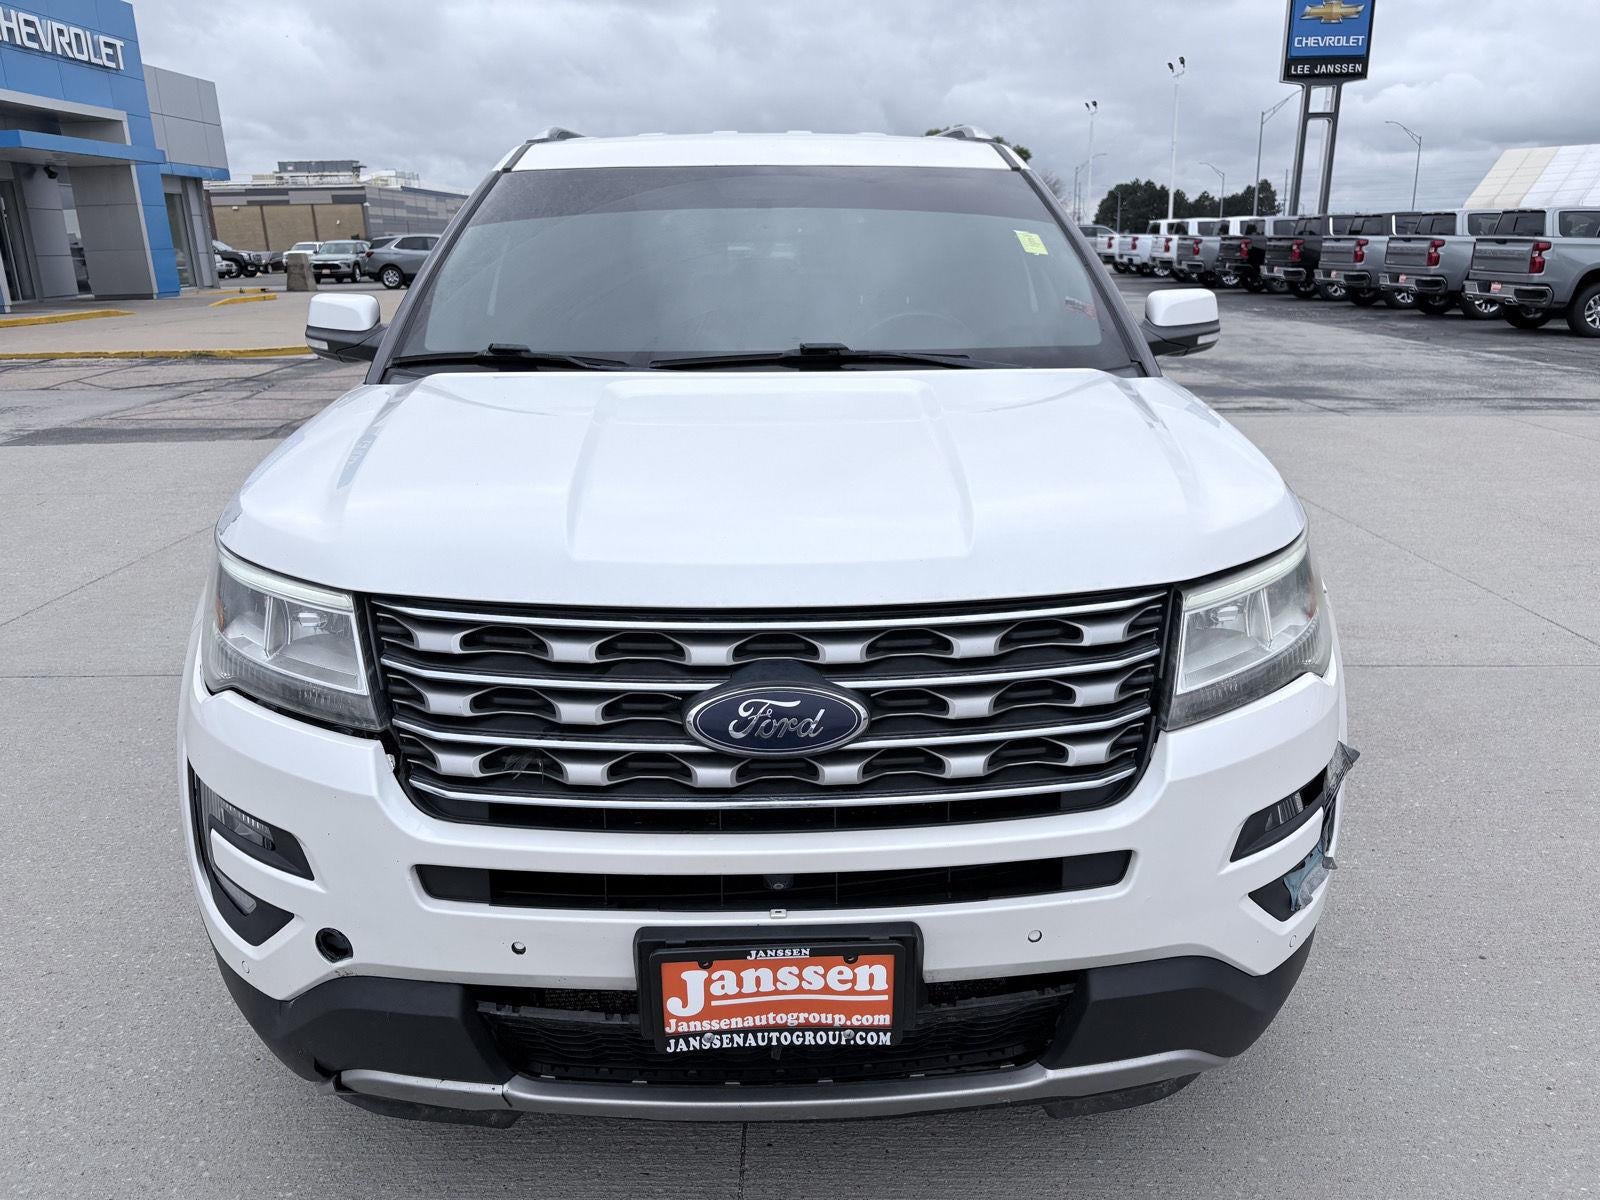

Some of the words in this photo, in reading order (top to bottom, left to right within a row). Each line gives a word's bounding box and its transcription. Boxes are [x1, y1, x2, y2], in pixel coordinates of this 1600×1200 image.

[0, 6, 124, 70] HEVROLET
[1294, 35, 1365, 47] CHEVROLET
[1291, 65, 1310, 74] LEE
[1314, 63, 1362, 74] JANSSEN
[728, 698, 826, 739] Ford
[746, 948, 810, 960] JANSSEN
[666, 964, 888, 1016] Janssen
[665, 1011, 891, 1033] Janssenautogroup.com
